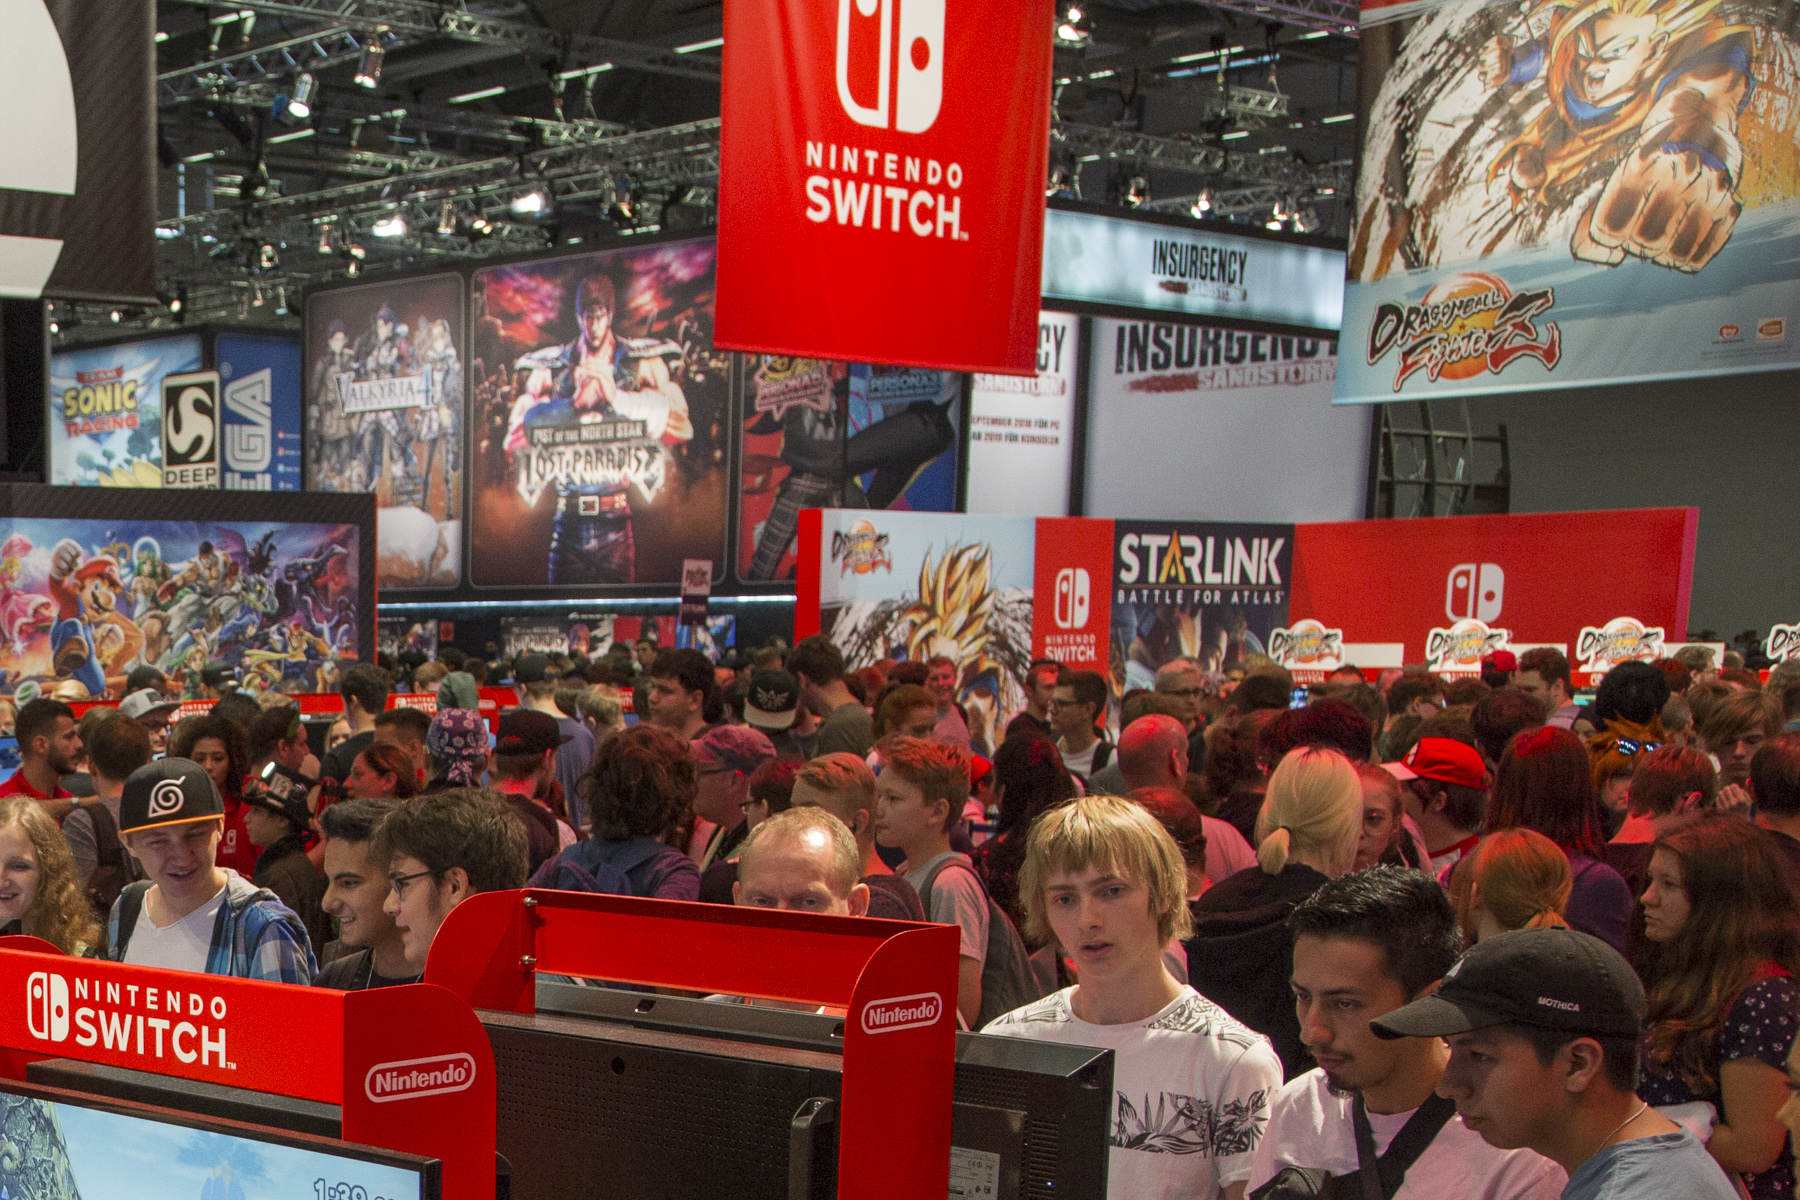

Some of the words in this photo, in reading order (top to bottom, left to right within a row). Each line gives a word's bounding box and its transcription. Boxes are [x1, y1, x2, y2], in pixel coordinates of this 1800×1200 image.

[806, 141, 963, 187] NINTENDO
[805, 176, 961, 241] SWITCH
[1153, 239, 1247, 285] INSURGENCY
[63, 379, 139, 418] SONIC
[335, 372, 416, 416] VALKYRIA
[416, 364, 435, 407] 4
[64, 414, 140, 437] RACING
[581, 423, 615, 441] NORTH
[618, 421, 644, 438] STAR
[166, 467, 218, 486] DEEP
[517, 448, 566, 508] LOST
[1119, 530, 1285, 584] STARLINK
[1117, 589, 1183, 605] BATTLE
[1194, 590, 1221, 605] FOR
[1230, 590, 1282, 605] ATLAS
[1045, 634, 1096, 645] NINTENDO
[1045, 645, 1096, 661] SWITCH
[75, 977, 226, 1020] NINTENDO
[868, 1001, 935, 1027] Nintendo
[1538, 996, 1580, 1012] MOTHICA
[75, 1007, 226, 1068] SWITCH
[375, 1063, 466, 1094] Nintendo
